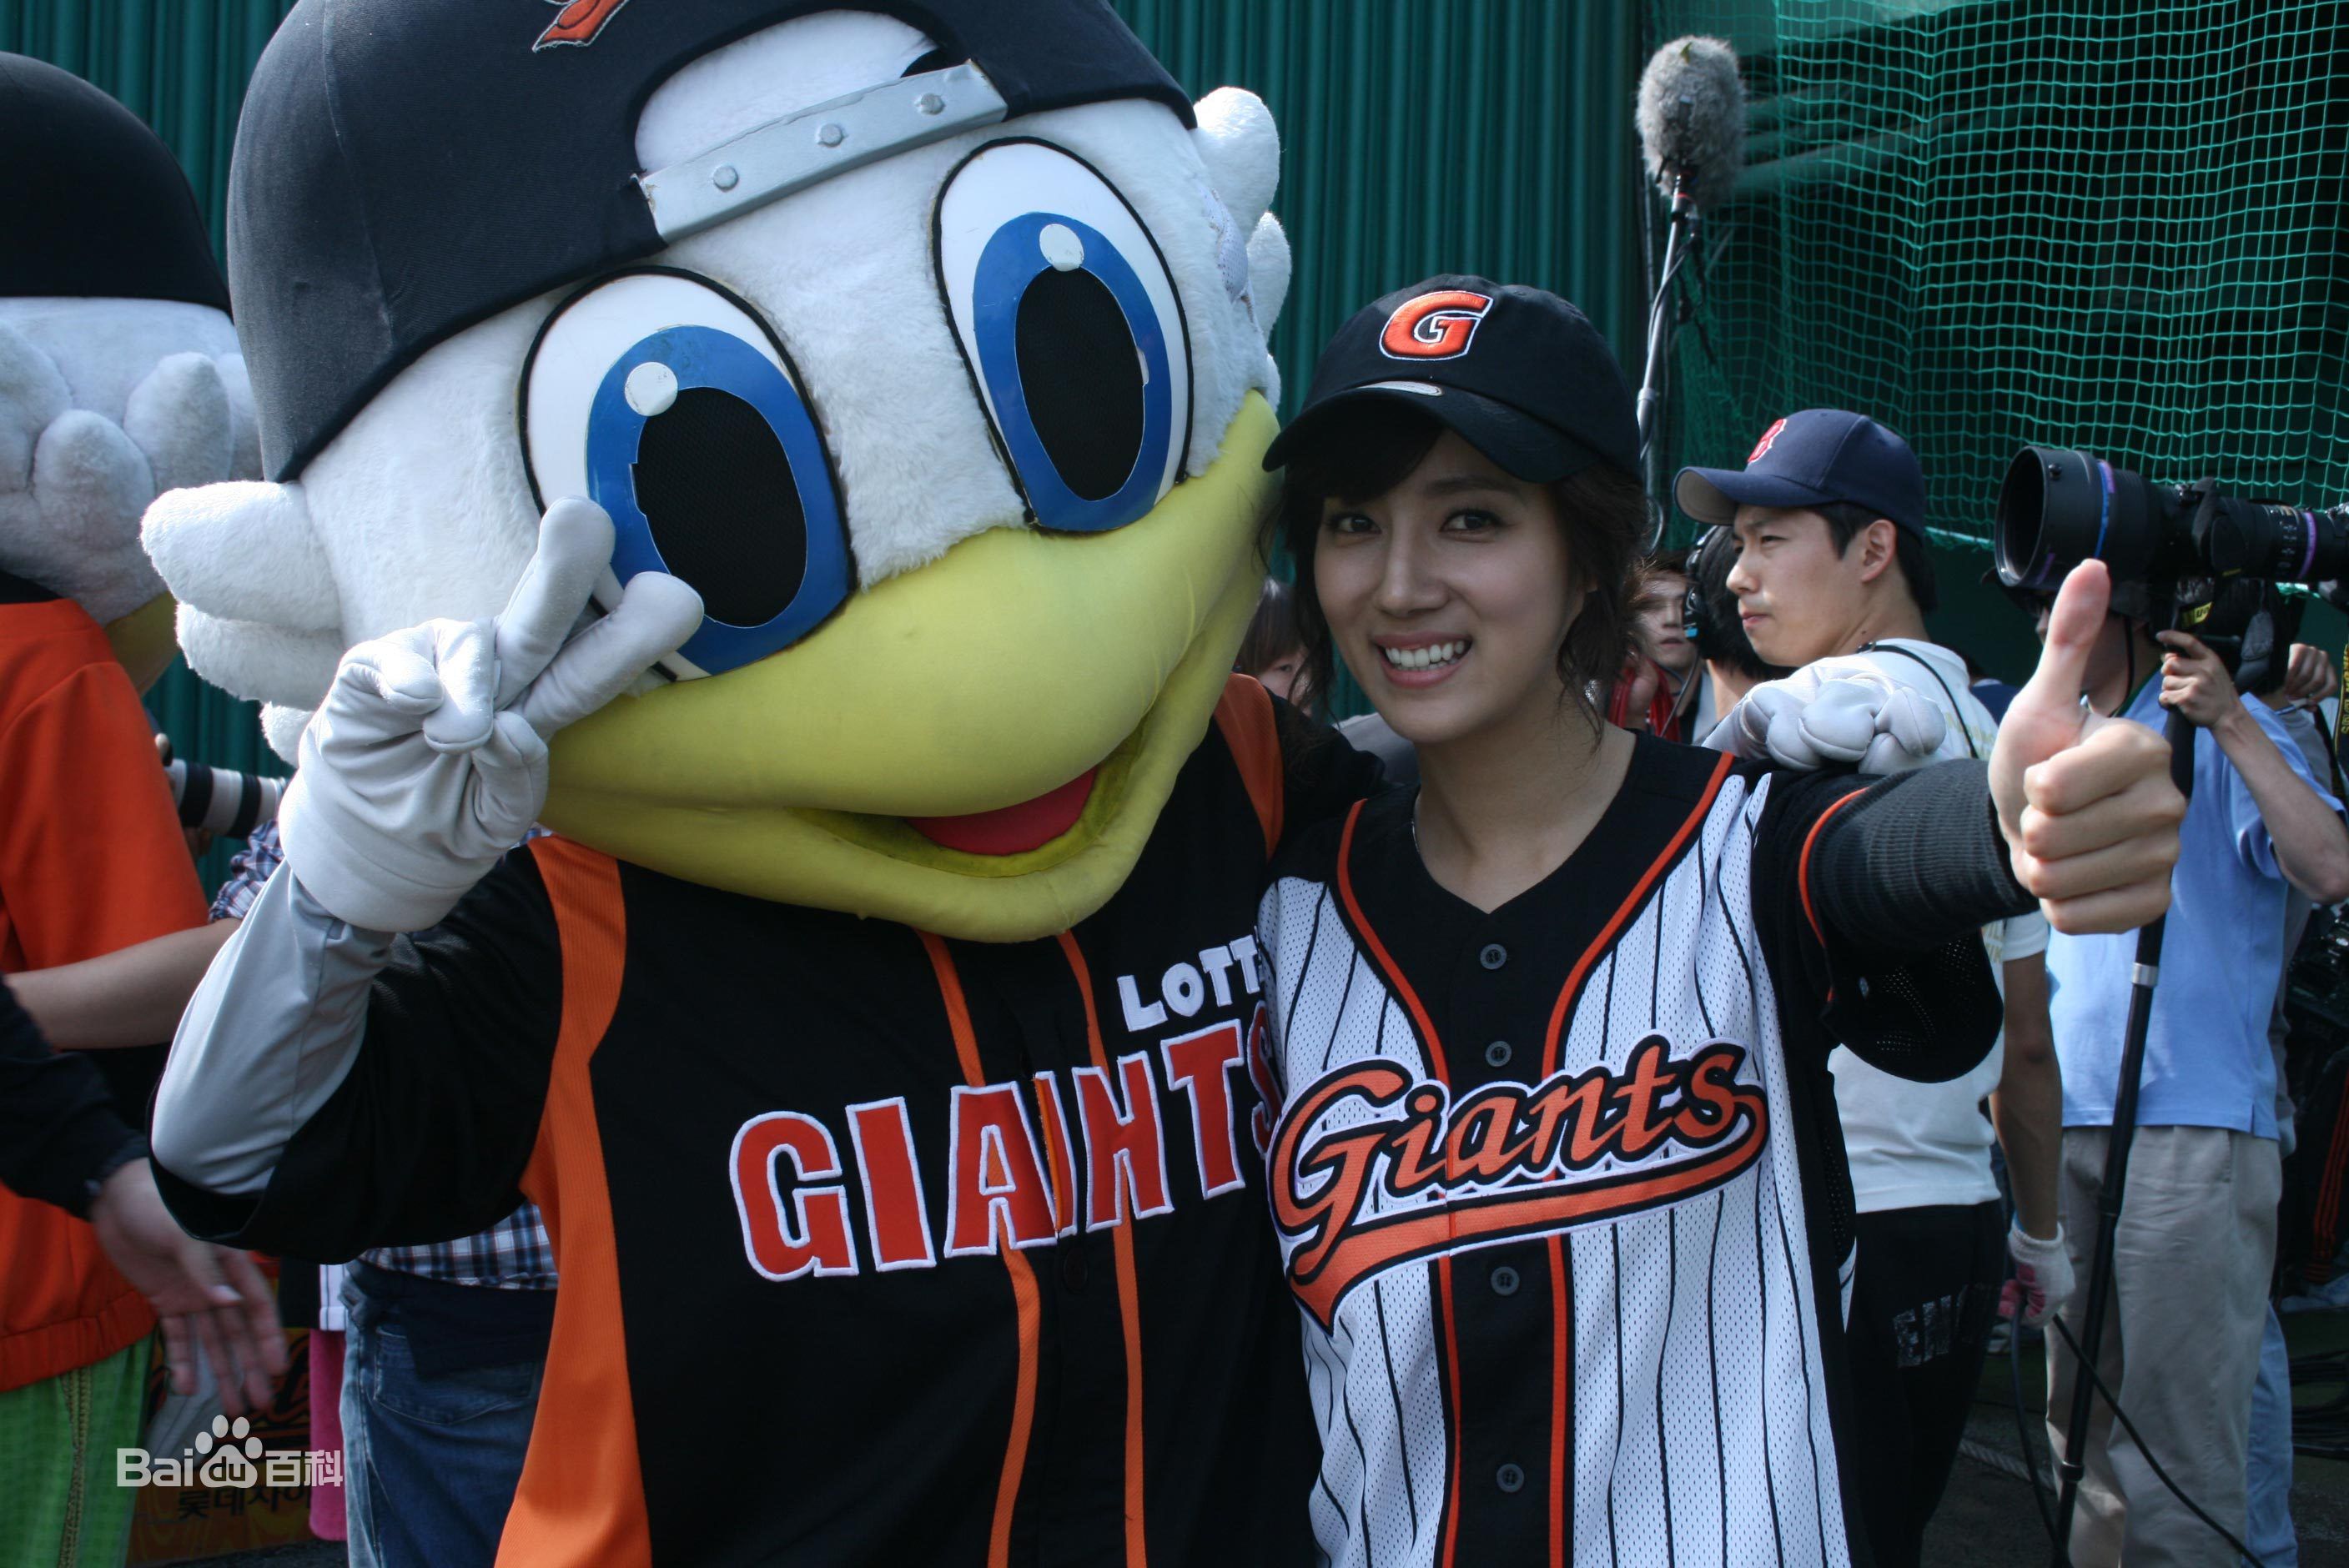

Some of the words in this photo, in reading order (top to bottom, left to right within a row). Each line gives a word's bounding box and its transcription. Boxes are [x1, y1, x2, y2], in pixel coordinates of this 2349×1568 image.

[1380, 290, 1492, 361] G
[1117, 928, 1262, 1032] LOTT
[1268, 1029, 1768, 1334] Giants
